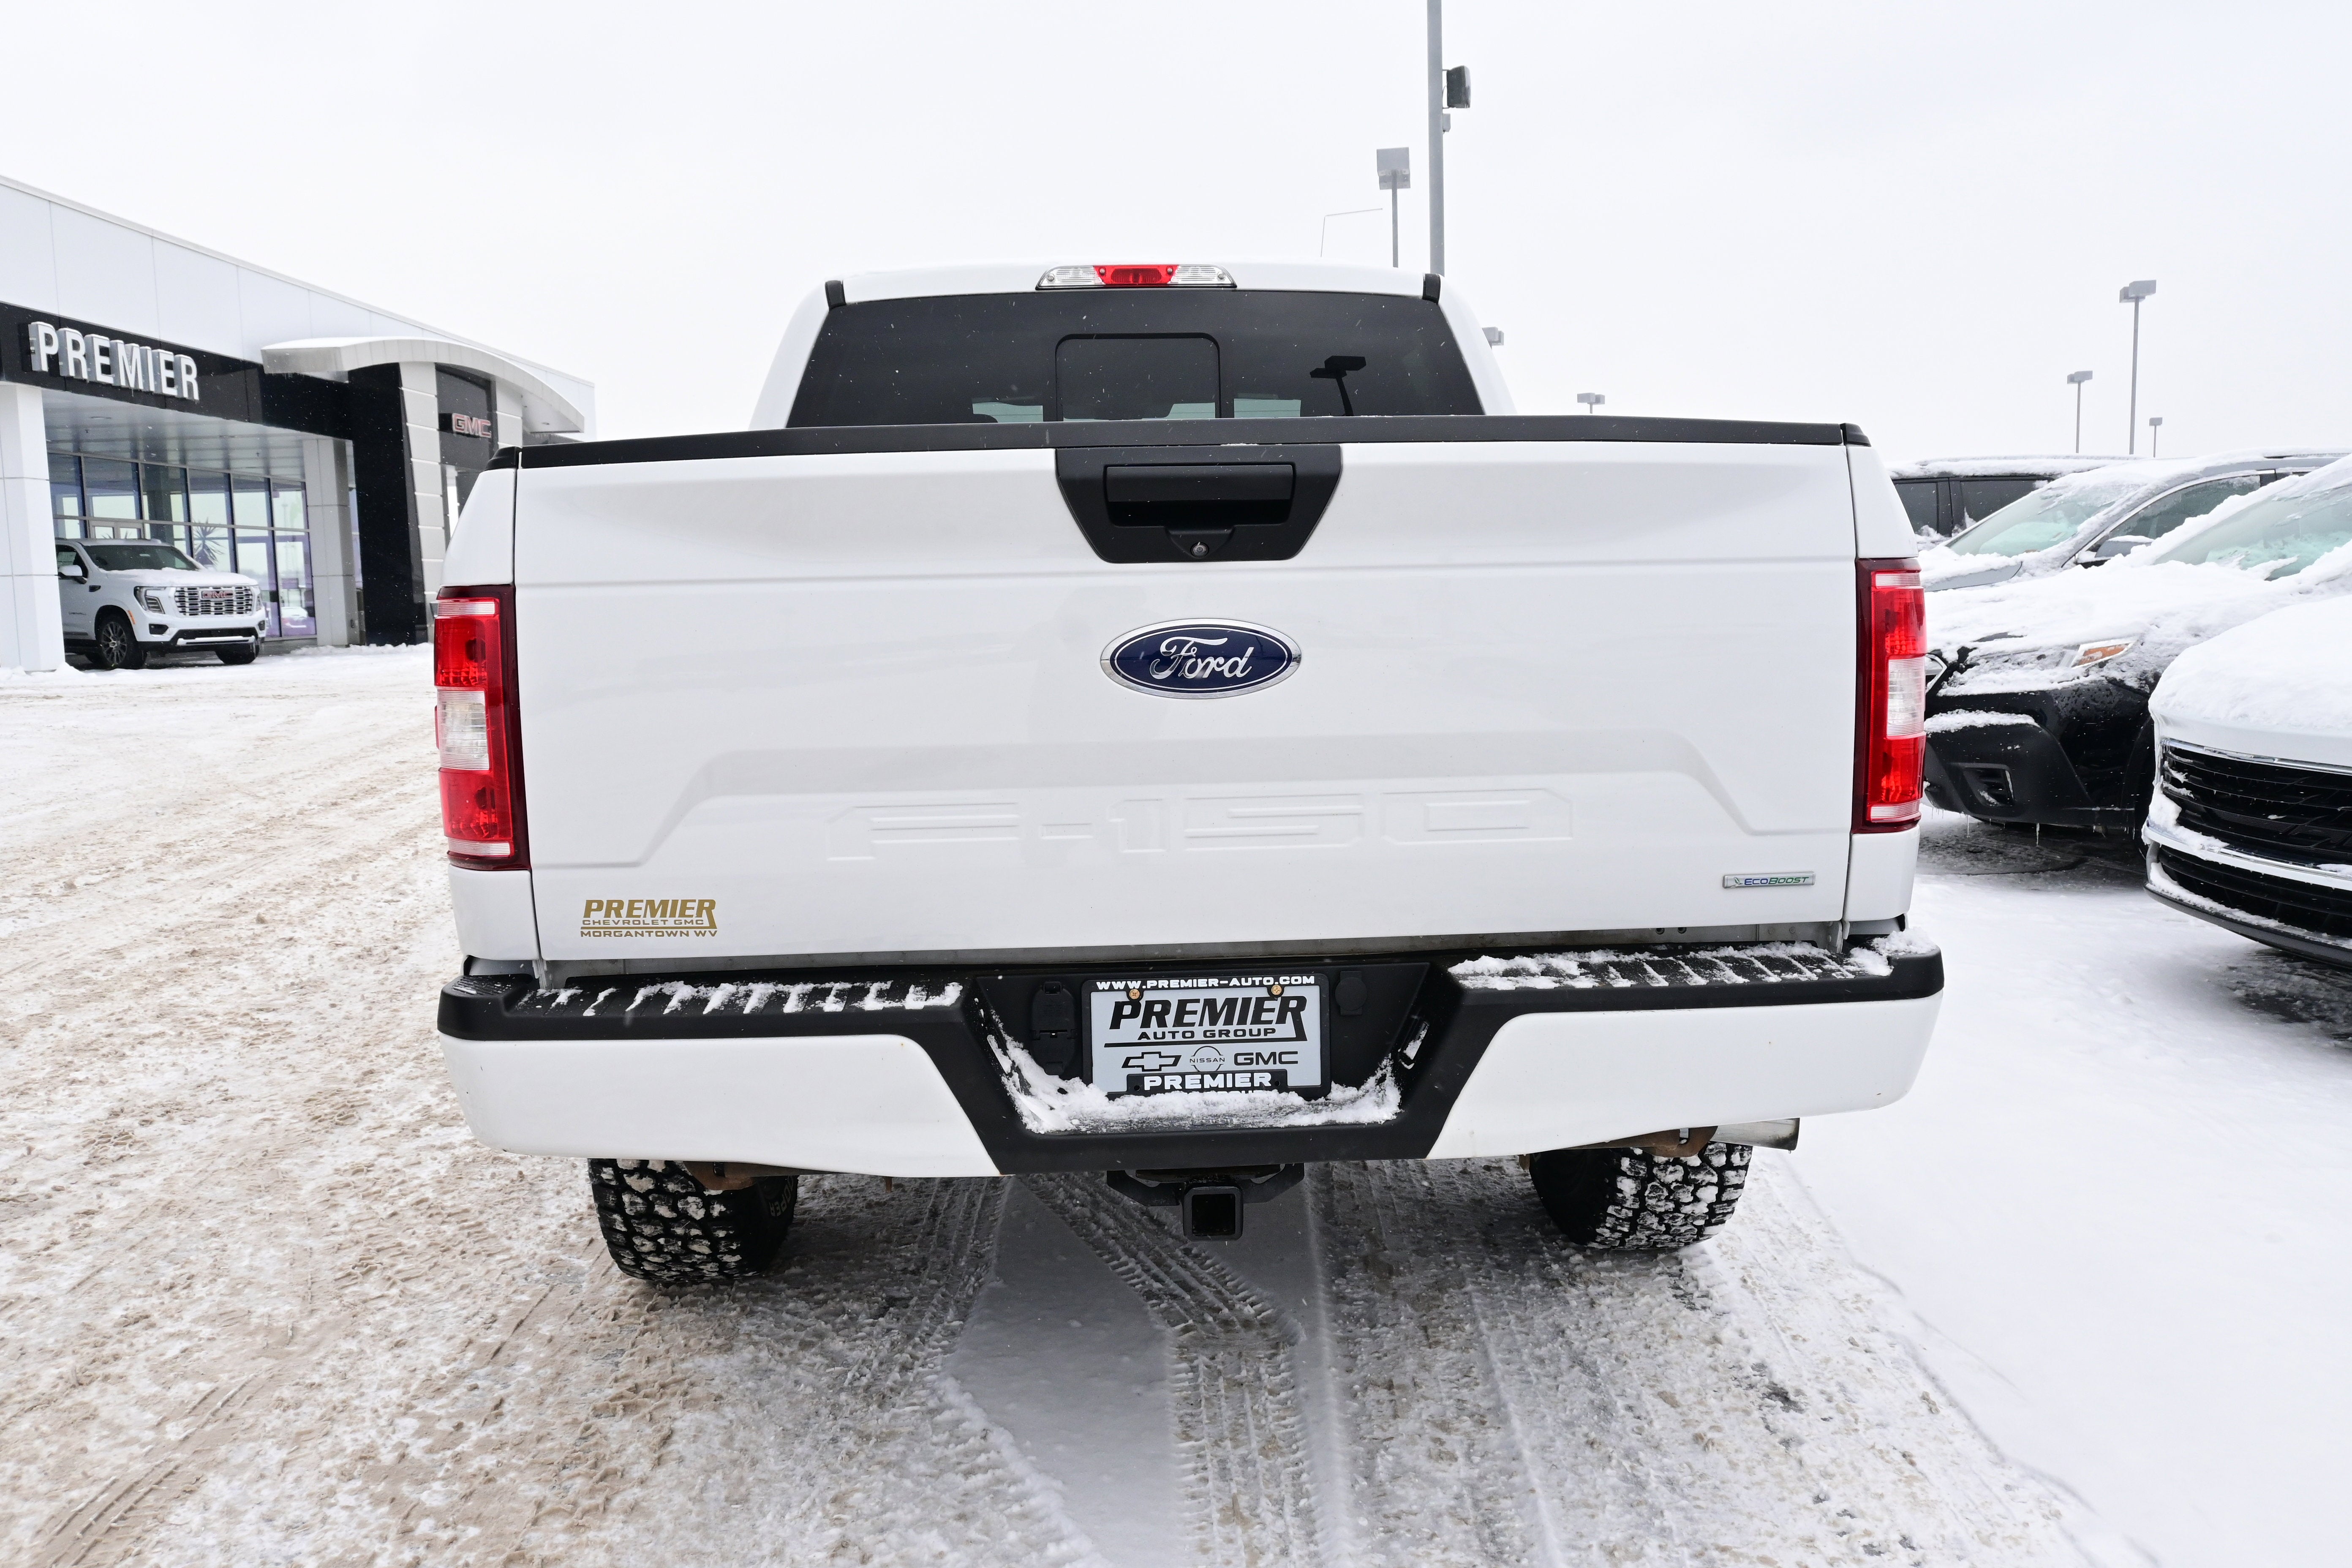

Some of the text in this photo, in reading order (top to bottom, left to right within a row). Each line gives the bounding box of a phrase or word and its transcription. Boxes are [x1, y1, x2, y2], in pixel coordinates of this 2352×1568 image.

[29, 321, 199, 400] PREMIER
[452, 413, 491, 438] GMC
[1149, 636, 1254, 679] Ford
[825, 787, 1573, 860] F-150
[583, 899, 717, 929] PREMIER
[1096, 976, 1315, 990] WWW.PREMIER-AUTO.COM
[1109, 996, 1308, 1041] PREMIER
[1137, 1028, 1276, 1040] AUTO GROUP
[1234, 1051, 1298, 1066] GMC
[1144, 1072, 1271, 1090] PREMIER
[768, 1176, 793, 1217] OOPER
